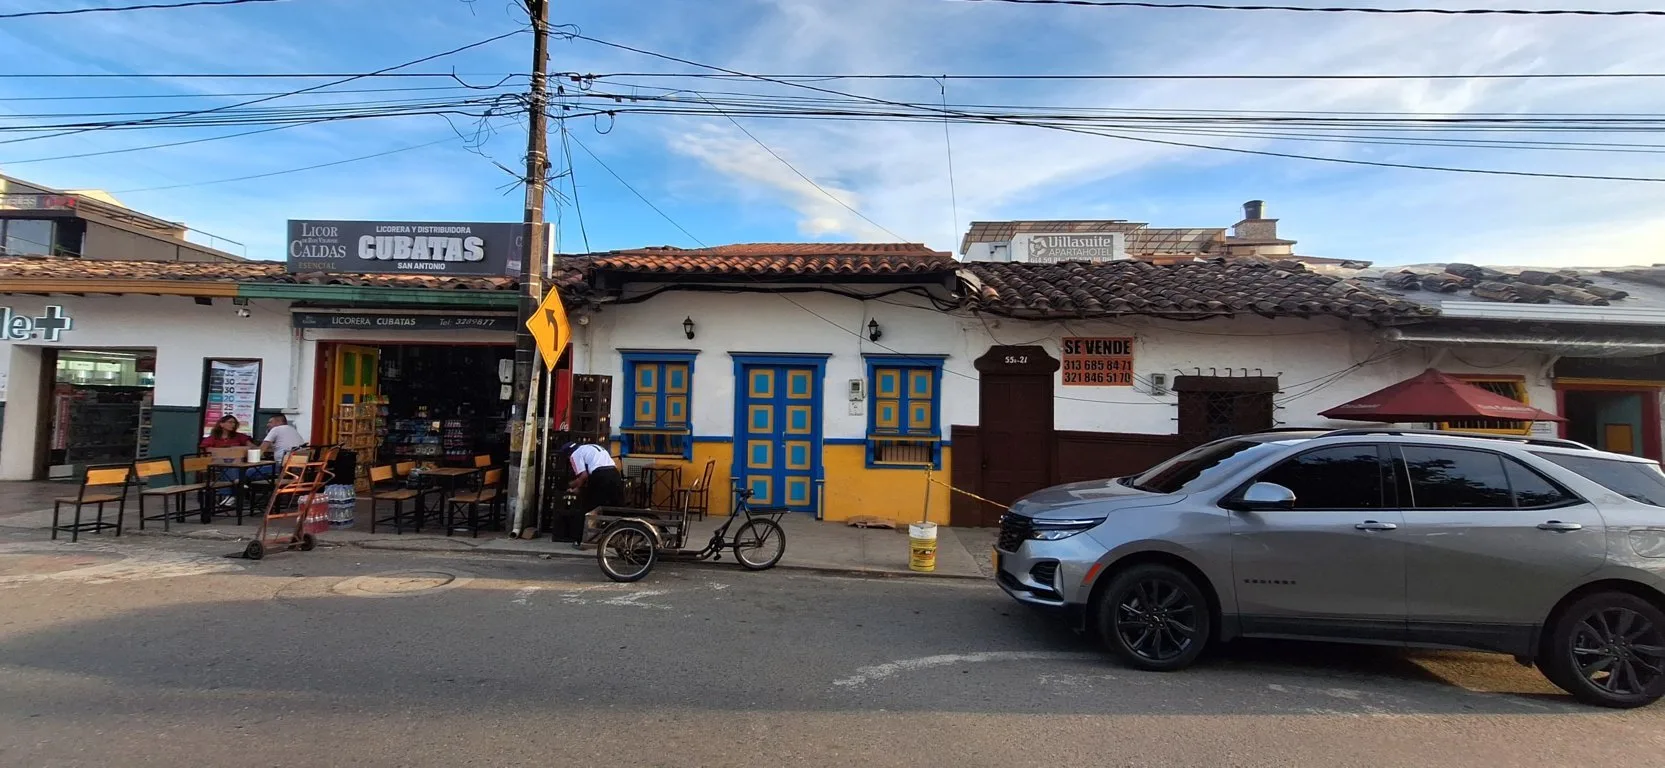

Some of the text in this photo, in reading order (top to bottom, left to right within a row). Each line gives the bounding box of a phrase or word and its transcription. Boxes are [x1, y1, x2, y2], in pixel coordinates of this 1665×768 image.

[301, 222, 338, 237] LICOR
[376, 225, 410, 233] LICORERA
[417, 226, 471, 234] DISTRIBUIDORA
[290, 239, 346, 258] CALDAS
[357, 234, 484, 262] CUBATAS
[1048, 248, 1112, 256] APARTAHOTEL
[298, 261, 337, 269] ESENCIAL
[332, 316, 371, 326] LICORERA
[376, 317, 416, 326] CUBATAS
[1064, 339, 1130, 355] SE VENDE
[1064, 360, 1131, 371] 313 685 84 71
[1064, 372, 1131, 383] 321 846 51 70
[224, 386, 235, 394] 30
